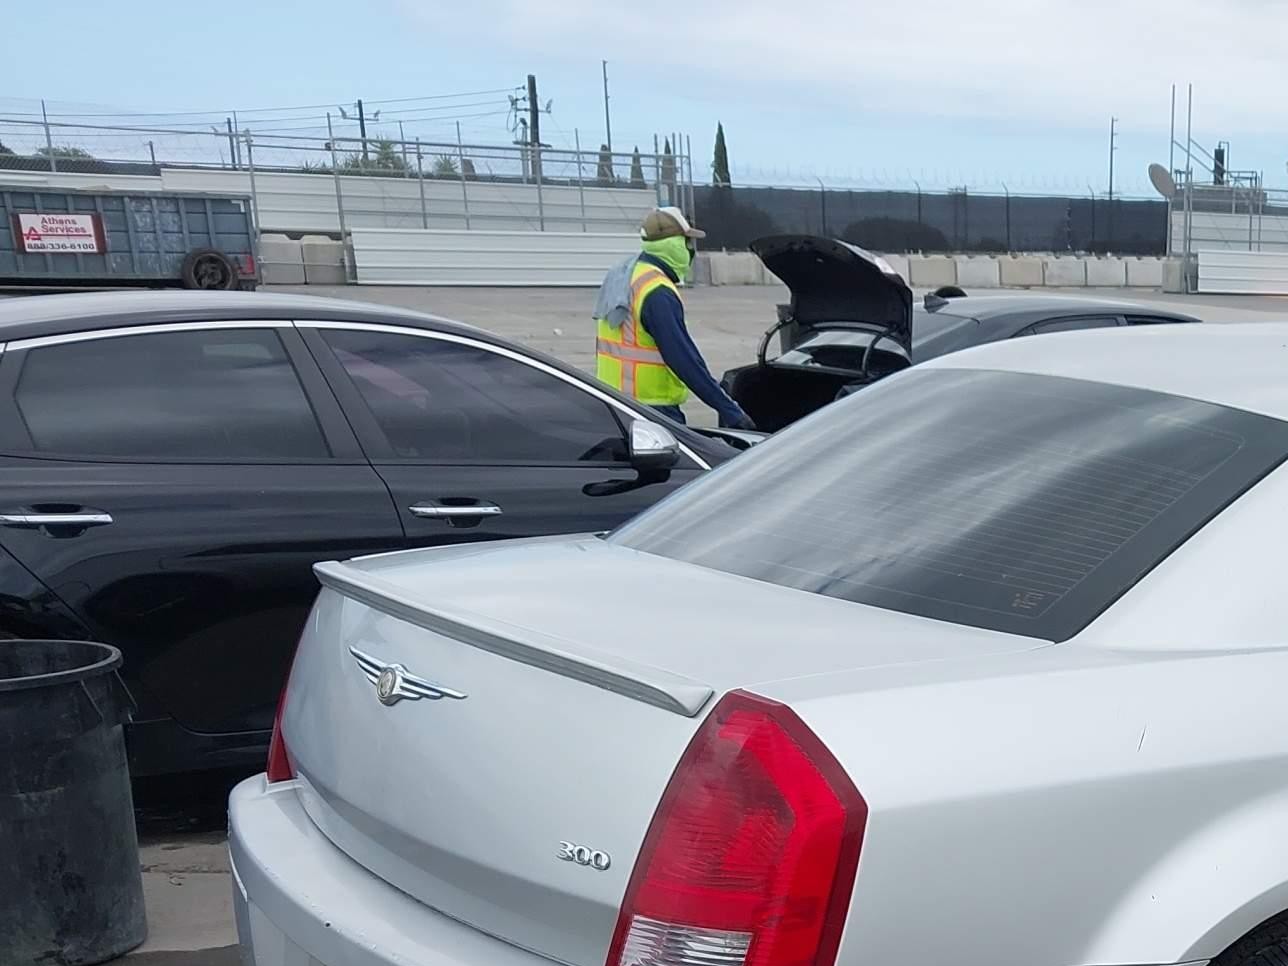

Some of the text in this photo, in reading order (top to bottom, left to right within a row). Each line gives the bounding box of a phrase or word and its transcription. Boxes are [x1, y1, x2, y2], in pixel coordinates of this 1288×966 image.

[40, 217, 77, 225] Athens
[41, 225, 87, 233] Services
[556, 839, 611, 871] 300
